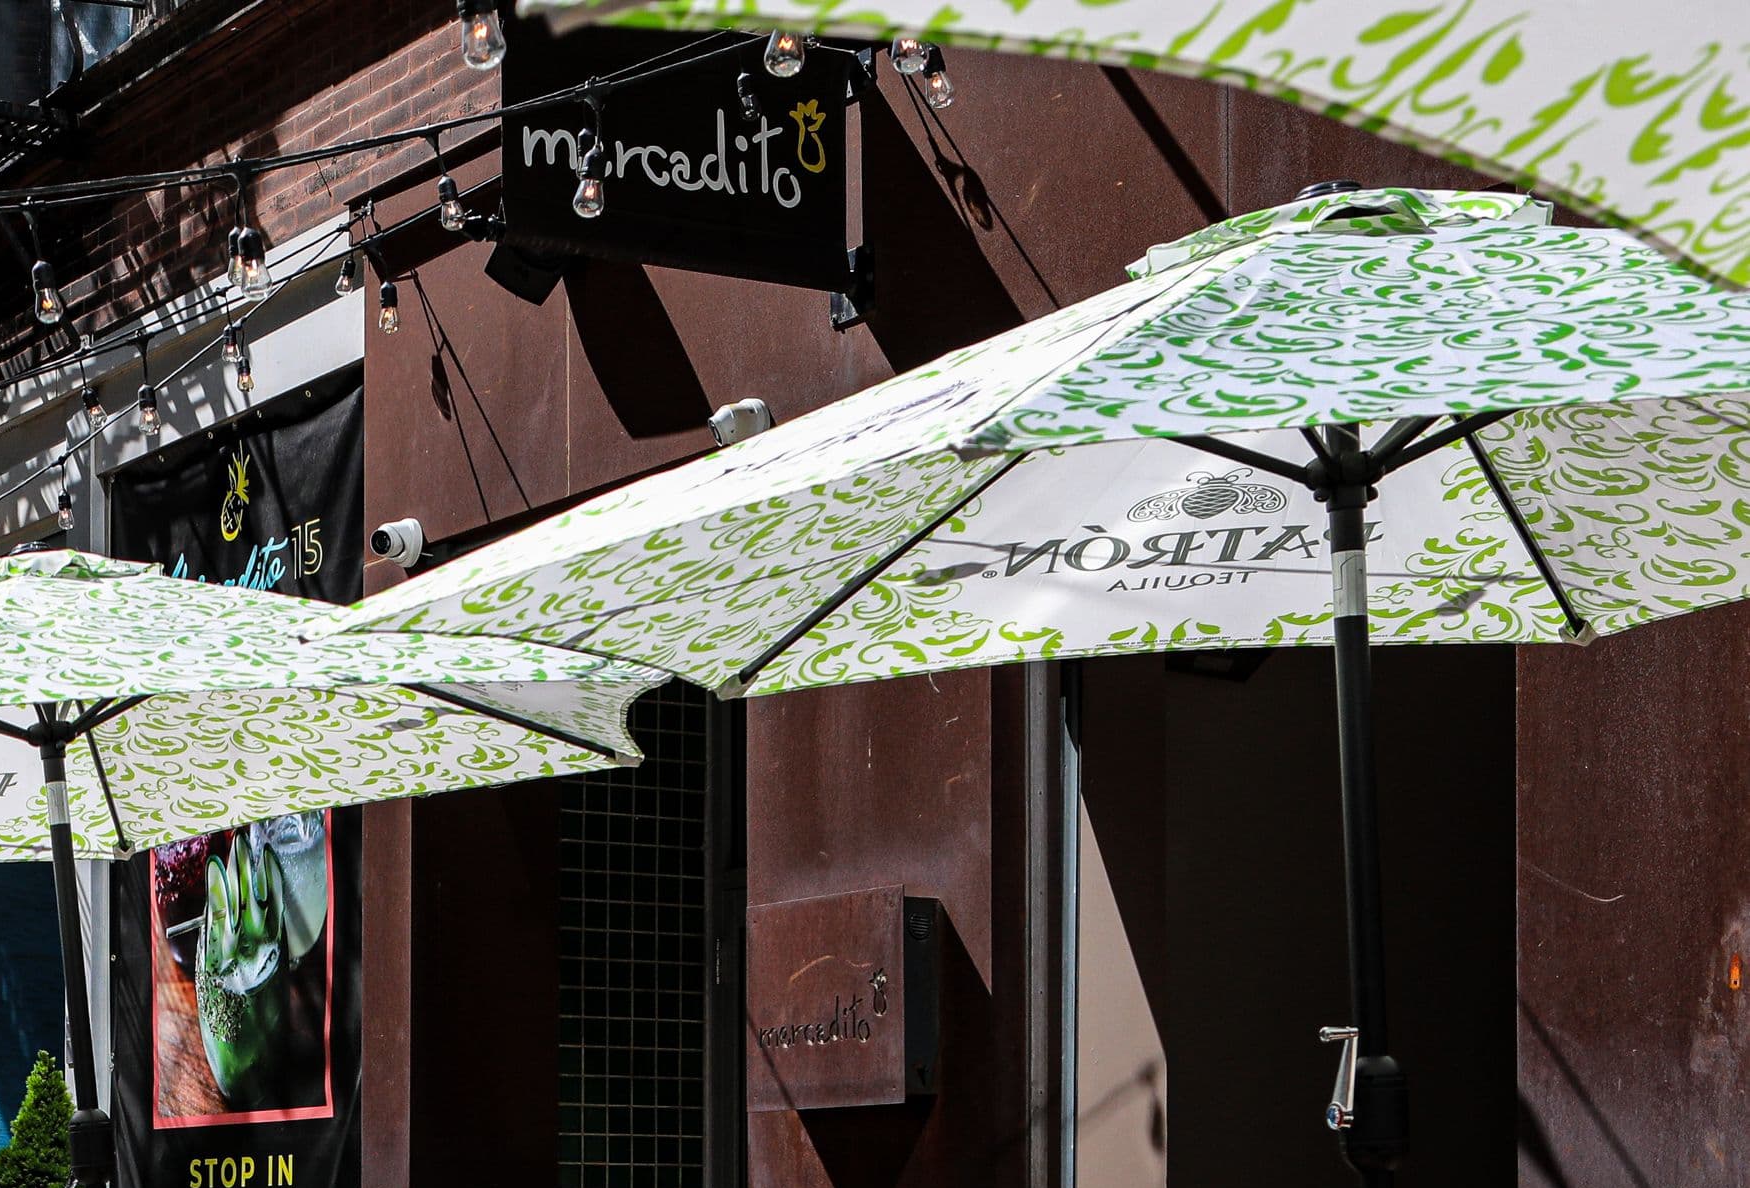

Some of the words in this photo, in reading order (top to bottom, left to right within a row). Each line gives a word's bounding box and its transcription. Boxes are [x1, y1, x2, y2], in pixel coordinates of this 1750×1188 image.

[523, 108, 801, 208] mrcadito
[291, 518, 323, 580] 15
[267, 1154, 294, 1187] IN
